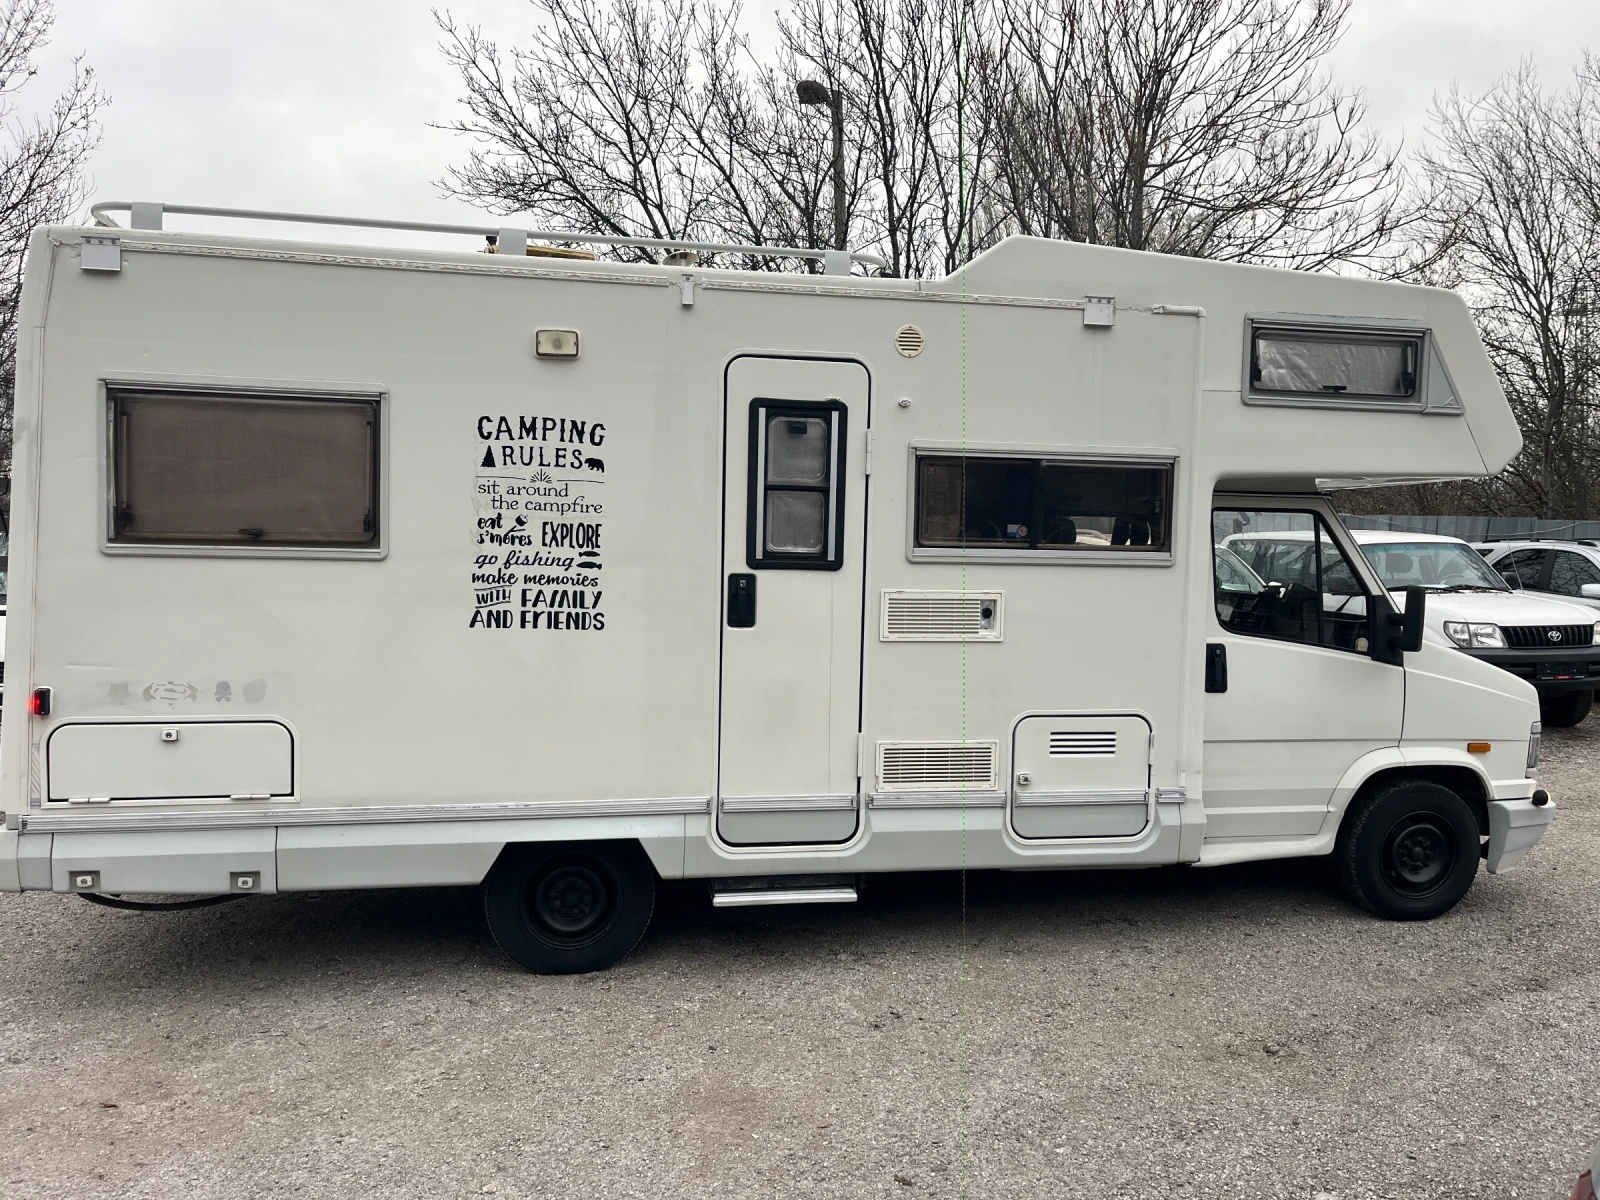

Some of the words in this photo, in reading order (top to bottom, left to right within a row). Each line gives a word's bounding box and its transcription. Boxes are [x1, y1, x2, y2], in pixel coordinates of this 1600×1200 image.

[477, 416, 606, 446] CAMPING
[502, 446, 583, 469] RULES
[478, 480, 500, 494] sit
[506, 483, 569, 498] around
[491, 495, 519, 510] the
[525, 496, 603, 516] campfire
[477, 512, 503, 530] eat
[542, 521, 602, 550] EXPLORE
[474, 554, 498, 569] go
[503, 550, 575, 571] fishing
[472, 568, 518, 585] make
[524, 573, 599, 587] memories
[476, 589, 511, 605] WITH
[521, 589, 603, 609] FAMILY
[469, 610, 513, 629] AND
